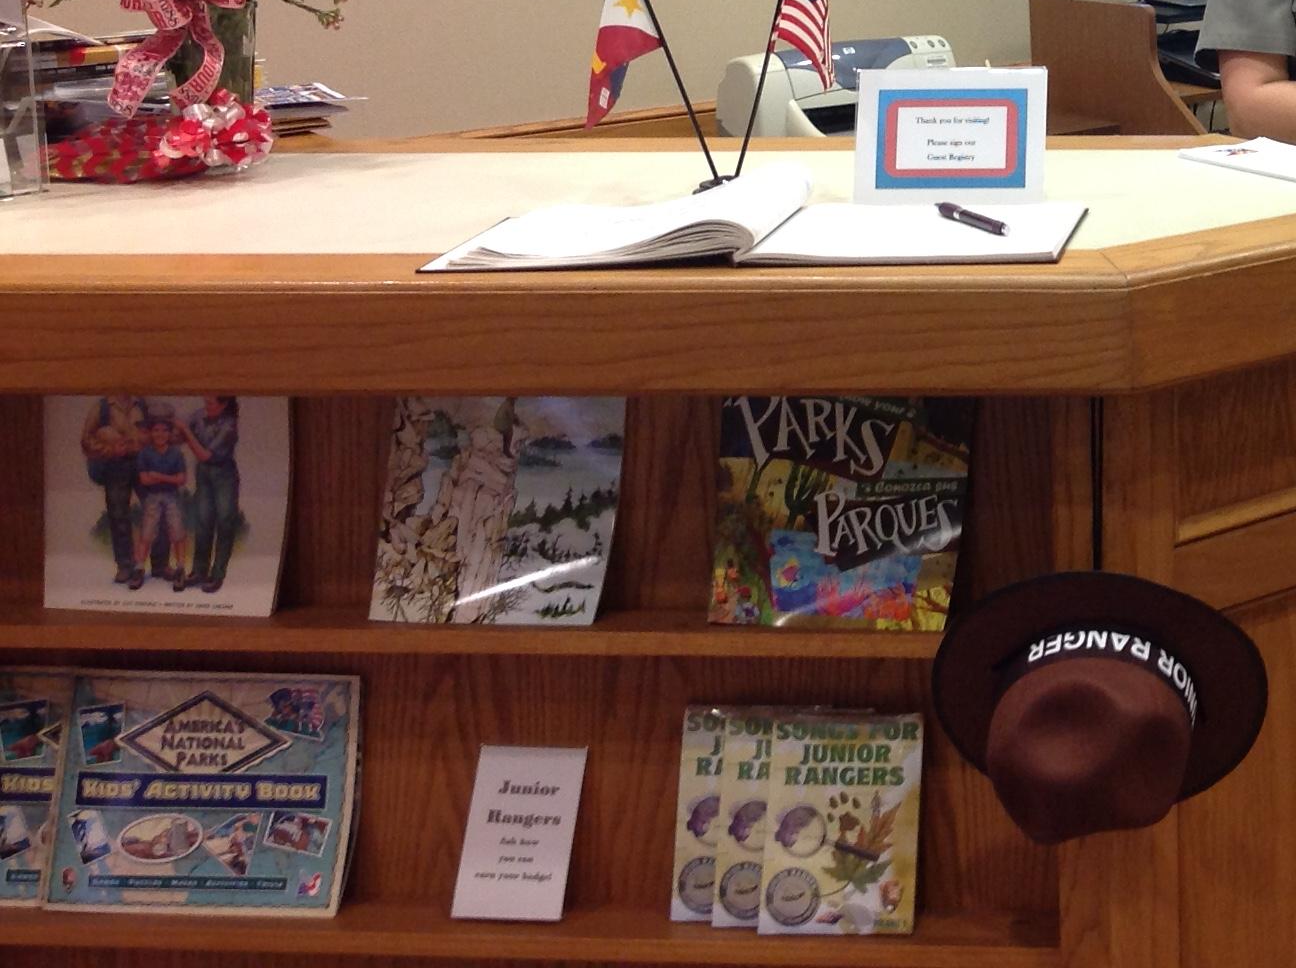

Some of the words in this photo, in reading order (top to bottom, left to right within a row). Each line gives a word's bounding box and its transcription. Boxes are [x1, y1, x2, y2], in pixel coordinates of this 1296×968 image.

[953, 116, 962, 124] for
[950, 139, 962, 147] sign
[949, 154, 975, 162] Registry
[724, 395, 895, 477] PARKS
[814, 490, 959, 558] PARQUES
[1027, 630, 1152, 663] RANGER
[163, 718, 246, 735] AMERICA'S
[776, 721, 858, 742] SONGS
[869, 721, 920, 742] FOR
[161, 735, 246, 751] NATIONAL
[175, 750, 229, 767] PARKS
[799, 743, 892, 765] JUNIOR
[783, 766, 906, 786] RANGERS
[143, 779, 252, 800] ACTIVITY
[257, 782, 321, 801] BOOK
[498, 779, 561, 796] Junior
[486, 809, 562, 829] Rangers
[498, 856, 515, 864] you
[498, 873, 520, 881] your
